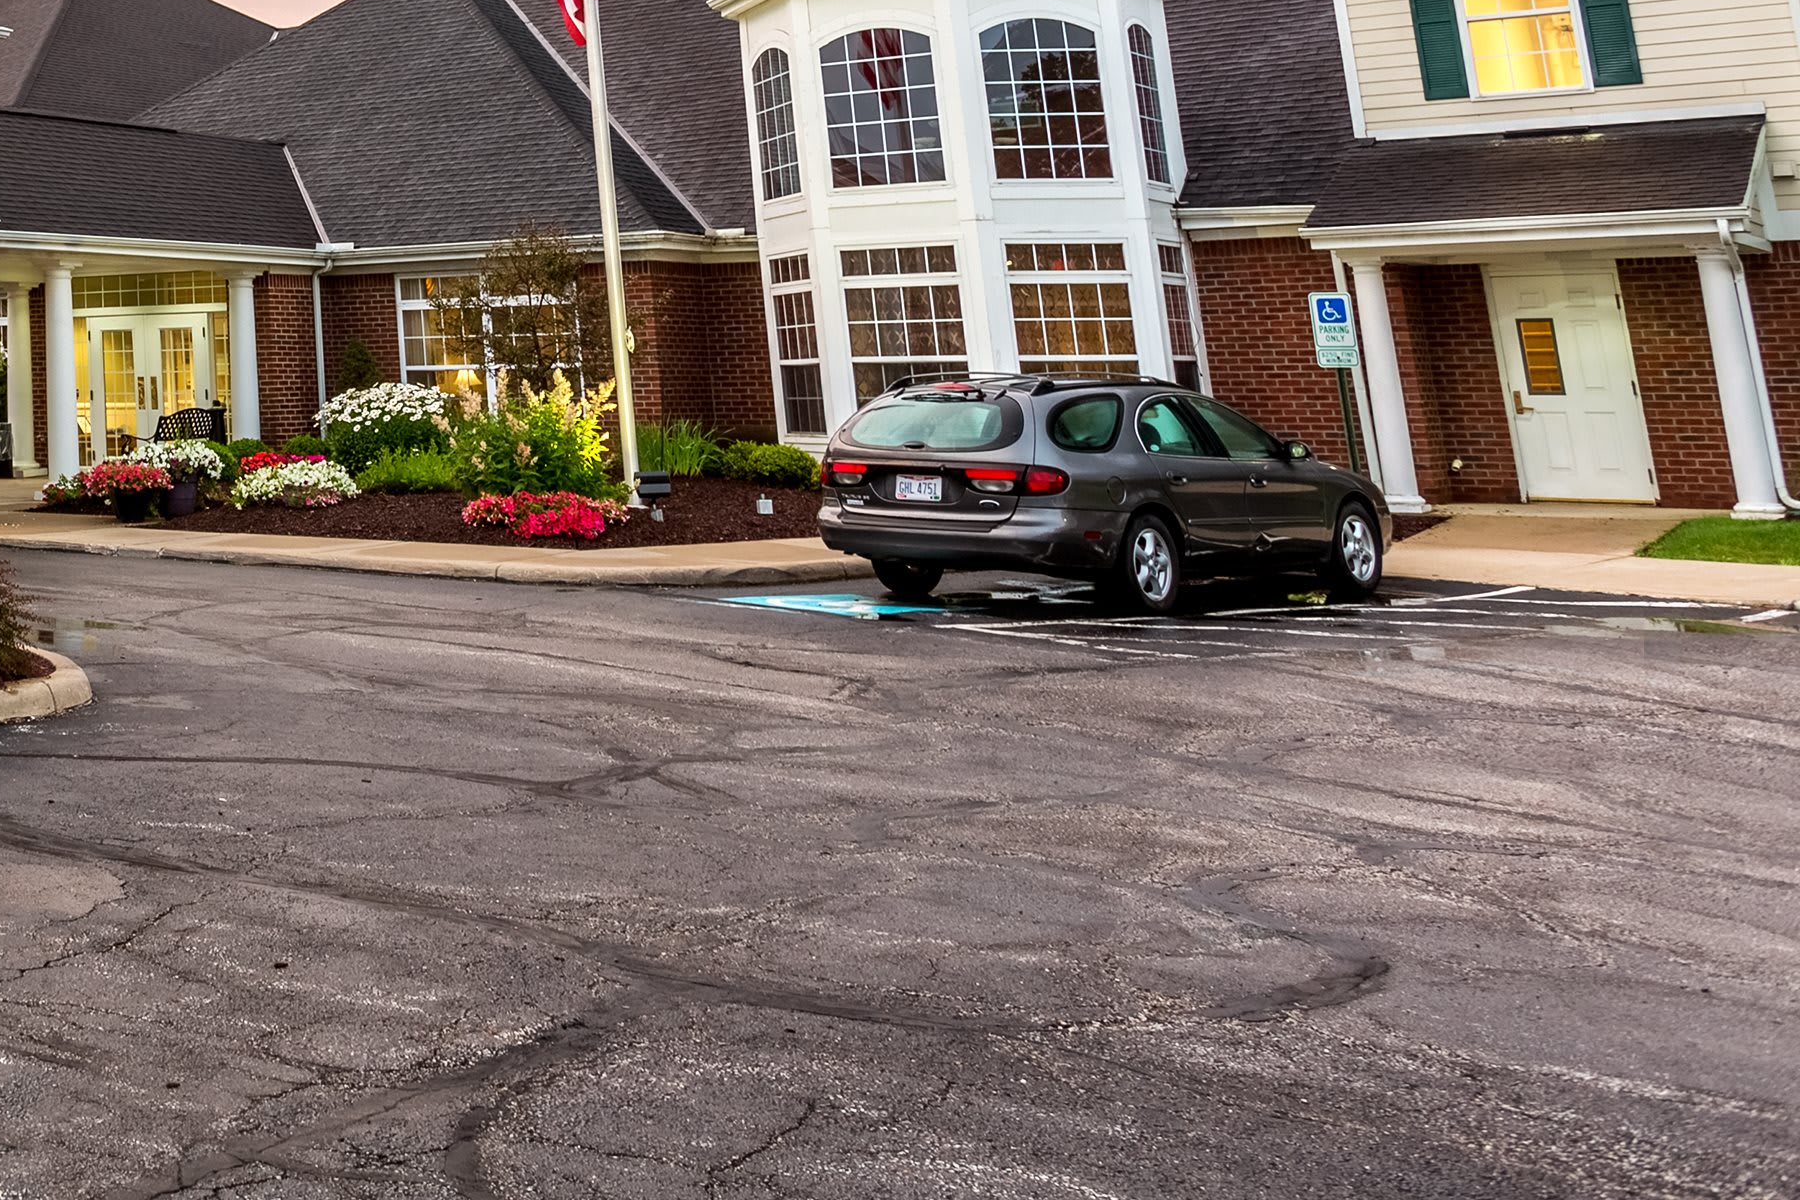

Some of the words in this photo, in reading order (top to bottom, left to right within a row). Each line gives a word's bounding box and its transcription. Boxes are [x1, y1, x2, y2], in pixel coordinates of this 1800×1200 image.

[1319, 325, 1349, 334] PARKING
[899, 481, 914, 494] GHL
[917, 482, 937, 495] 4751
